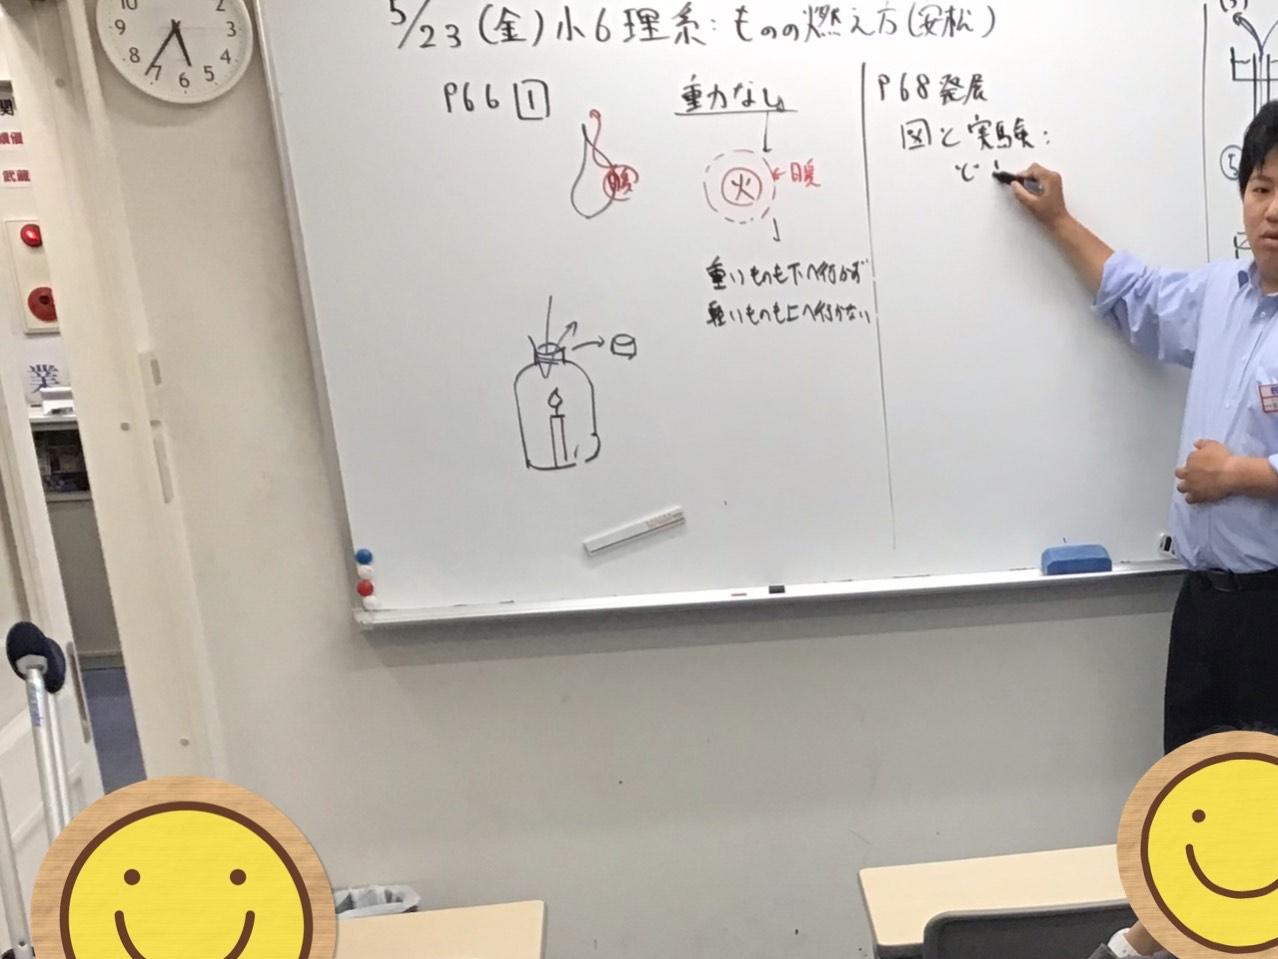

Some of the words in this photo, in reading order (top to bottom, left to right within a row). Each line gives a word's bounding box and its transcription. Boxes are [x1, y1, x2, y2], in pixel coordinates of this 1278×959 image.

[114, 19, 126, 35] 9
[226, 21, 237, 37] 3
[128, 47, 141, 63] 8
[219, 49, 231, 64] 4
[150, 65, 162, 81] 7
[178, 72, 190, 88] 6
[203, 65, 215, 82] 5
